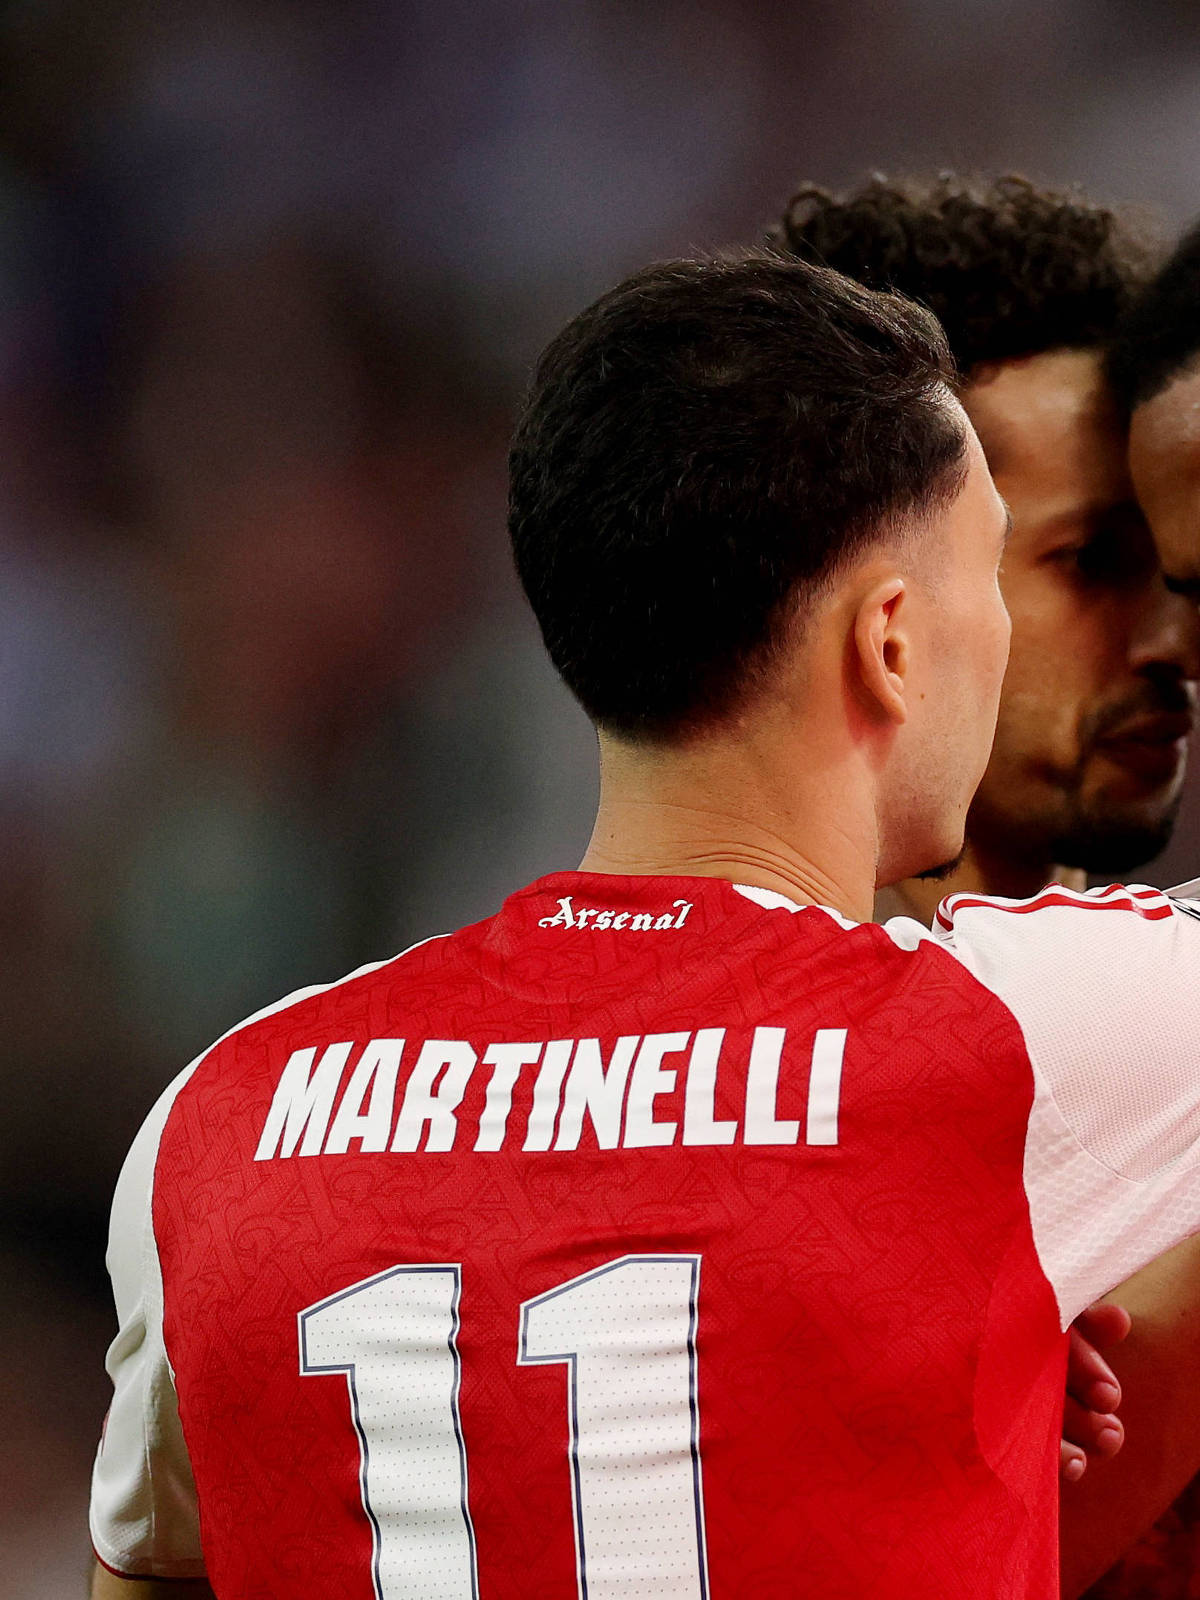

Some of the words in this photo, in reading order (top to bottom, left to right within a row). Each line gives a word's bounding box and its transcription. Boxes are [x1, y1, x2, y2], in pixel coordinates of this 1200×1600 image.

[537, 896, 694, 932] Arsenal
[253, 1026, 849, 1161] MARTINELLI
[297, 1254, 711, 1600] 11
